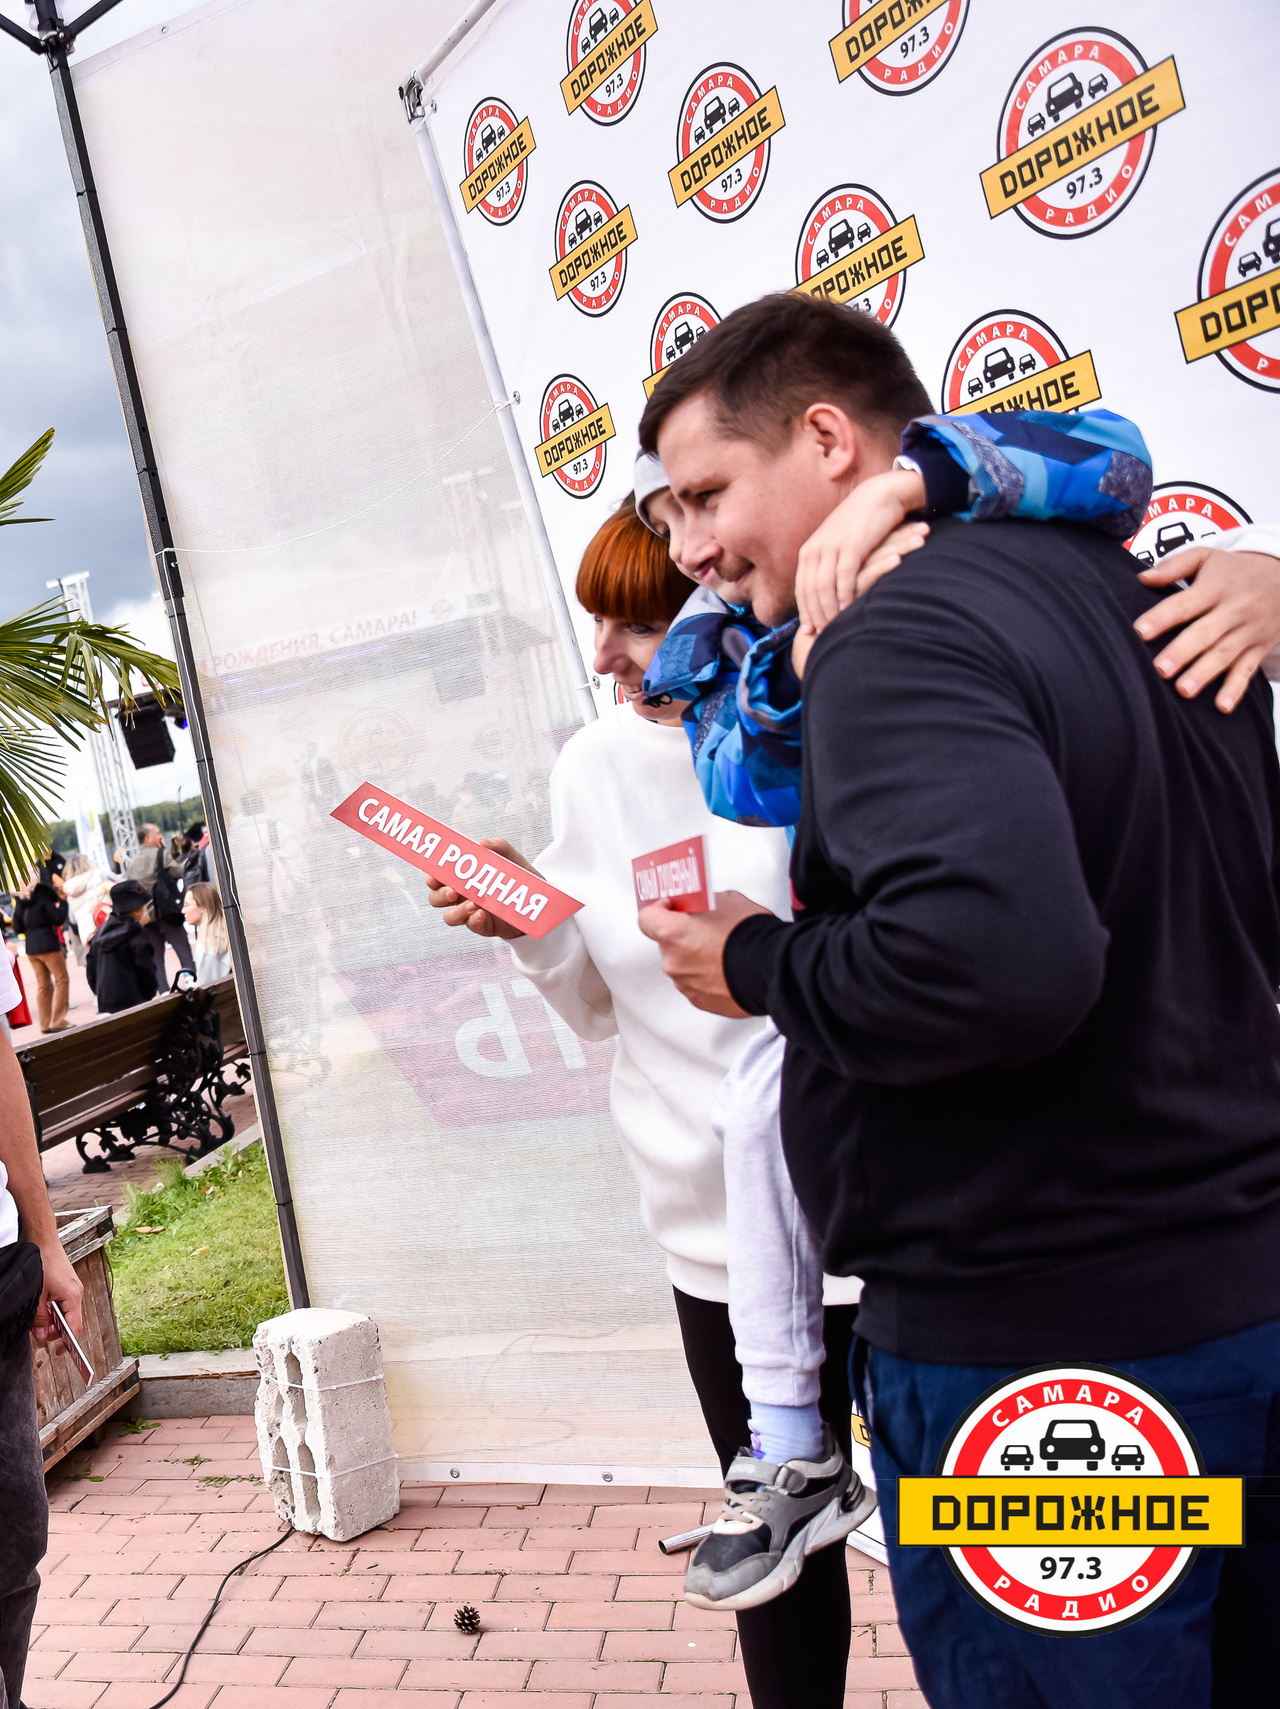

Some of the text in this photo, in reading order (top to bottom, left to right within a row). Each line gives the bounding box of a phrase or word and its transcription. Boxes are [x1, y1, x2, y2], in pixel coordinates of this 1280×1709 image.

[883, 22, 953, 81] РАДИО
[900, 26, 929, 59] 97.3
[596, 70, 638, 115] РАДИО
[605, 73, 624, 97] 97.3
[1015, 44, 1100, 110] САМАРА
[686, 75, 733, 124] САМАРА
[469, 107, 500, 146] САМАРА
[489, 180, 522, 217] РАДИО
[496, 181, 511, 202] 97.3
[710, 167, 760, 212] РАДИО
[721, 168, 743, 193] 97.3
[1045, 164, 1133, 223] РАДИО
[1066, 167, 1103, 199] 97.3
[561, 191, 597, 230] САМАРА
[807, 197, 864, 246] САМАРА
[582, 271, 620, 307] РАДИО
[590, 271, 607, 291] 97.3
[658, 303, 700, 342] САМАРА
[957, 324, 1029, 372] САМАРА
[545, 383, 578, 415] САМАРА
[566, 461, 600, 490] РАДИО
[572, 458, 589, 475] 97.3
[358, 798, 549, 922] САМАЯ РОДНАЯ
